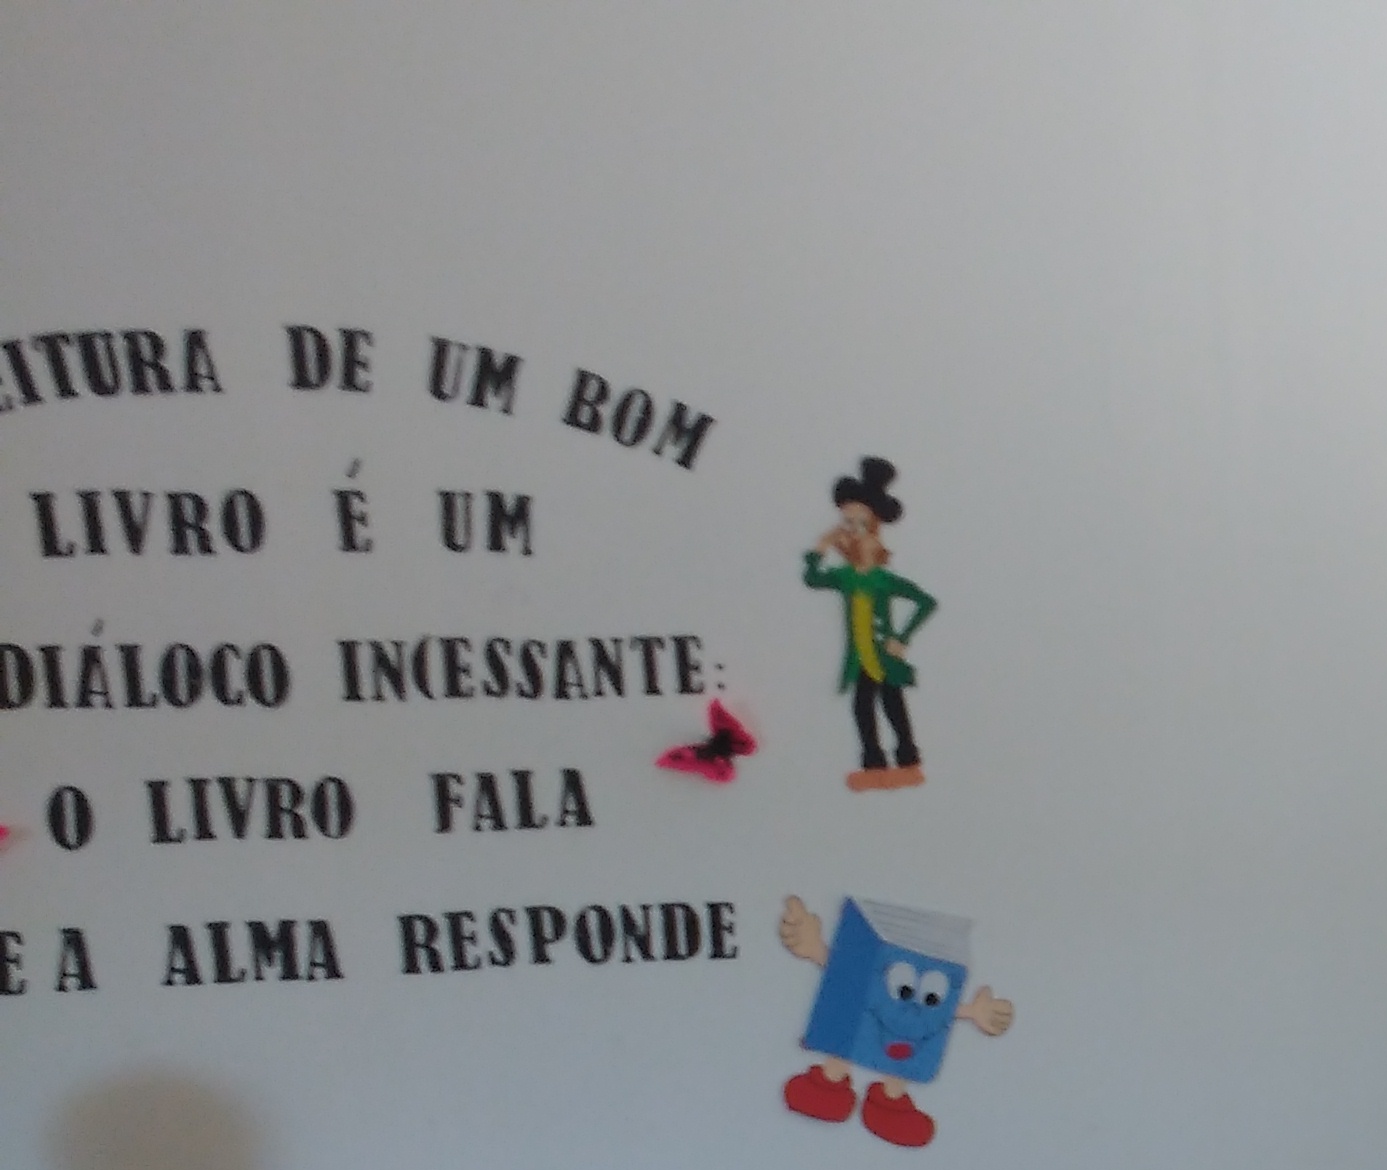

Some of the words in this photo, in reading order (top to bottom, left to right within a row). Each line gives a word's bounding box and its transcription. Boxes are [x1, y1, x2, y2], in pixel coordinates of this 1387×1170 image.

[284, 325, 373, 393] DE
[428, 336, 524, 416] UM
[561, 368, 716, 470] BOM
[28, 488, 267, 559] LIVRO
[331, 459, 374, 554] É
[437, 489, 534, 556] UM
[336, 635, 726, 703] INCESSANTE:
[44, 785, 96, 852] O
[144, 775, 356, 845] LIVRO
[428, 768, 595, 834] FALA
[0, 930, 28, 996] E
[53, 927, 98, 993] A
[160, 919, 345, 986] ALMA
[397, 901, 738, 975] RESPONDE
